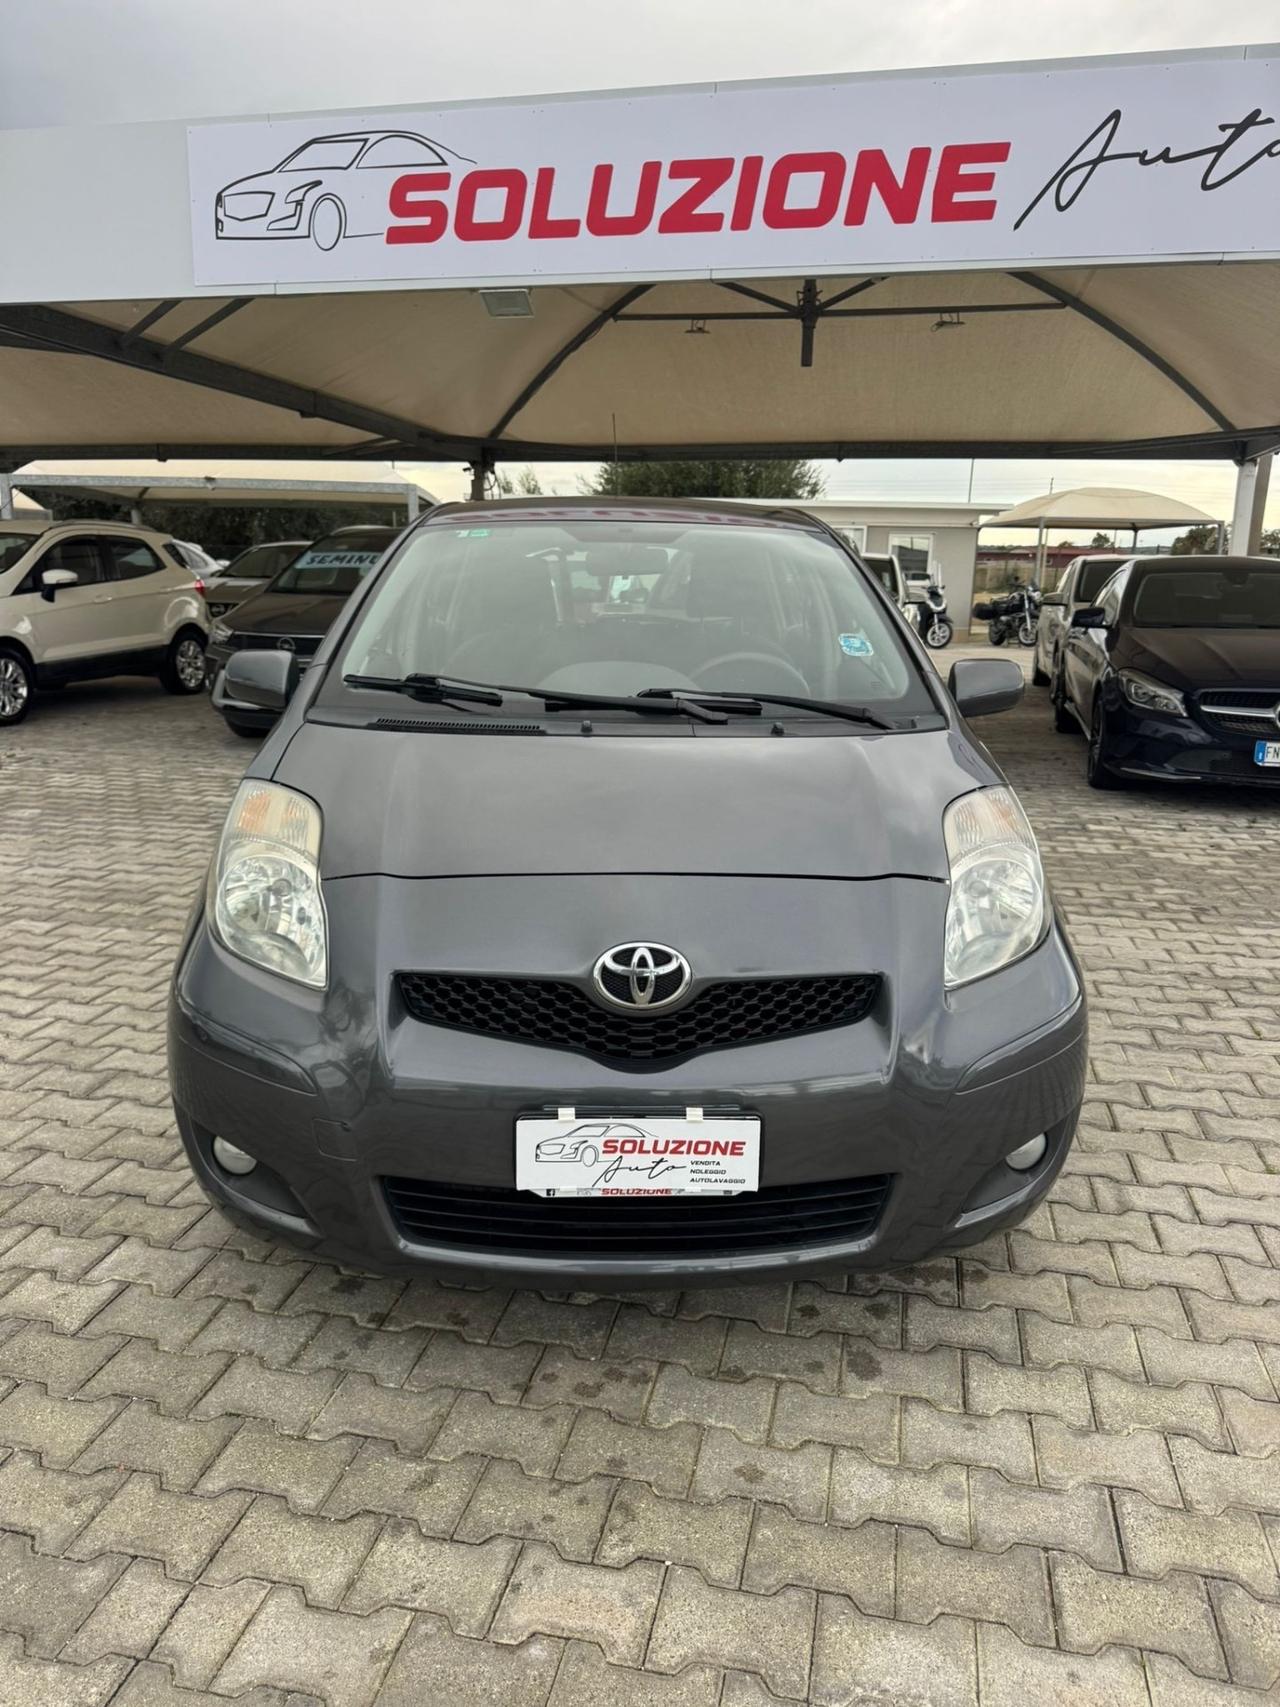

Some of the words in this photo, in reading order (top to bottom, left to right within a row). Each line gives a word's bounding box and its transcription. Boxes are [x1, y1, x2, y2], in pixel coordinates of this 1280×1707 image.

[386, 142, 1012, 245] SOLUZIONE
[602, 1140, 746, 1156] SOLUZIONE
[592, 1156, 686, 1187] Auto
